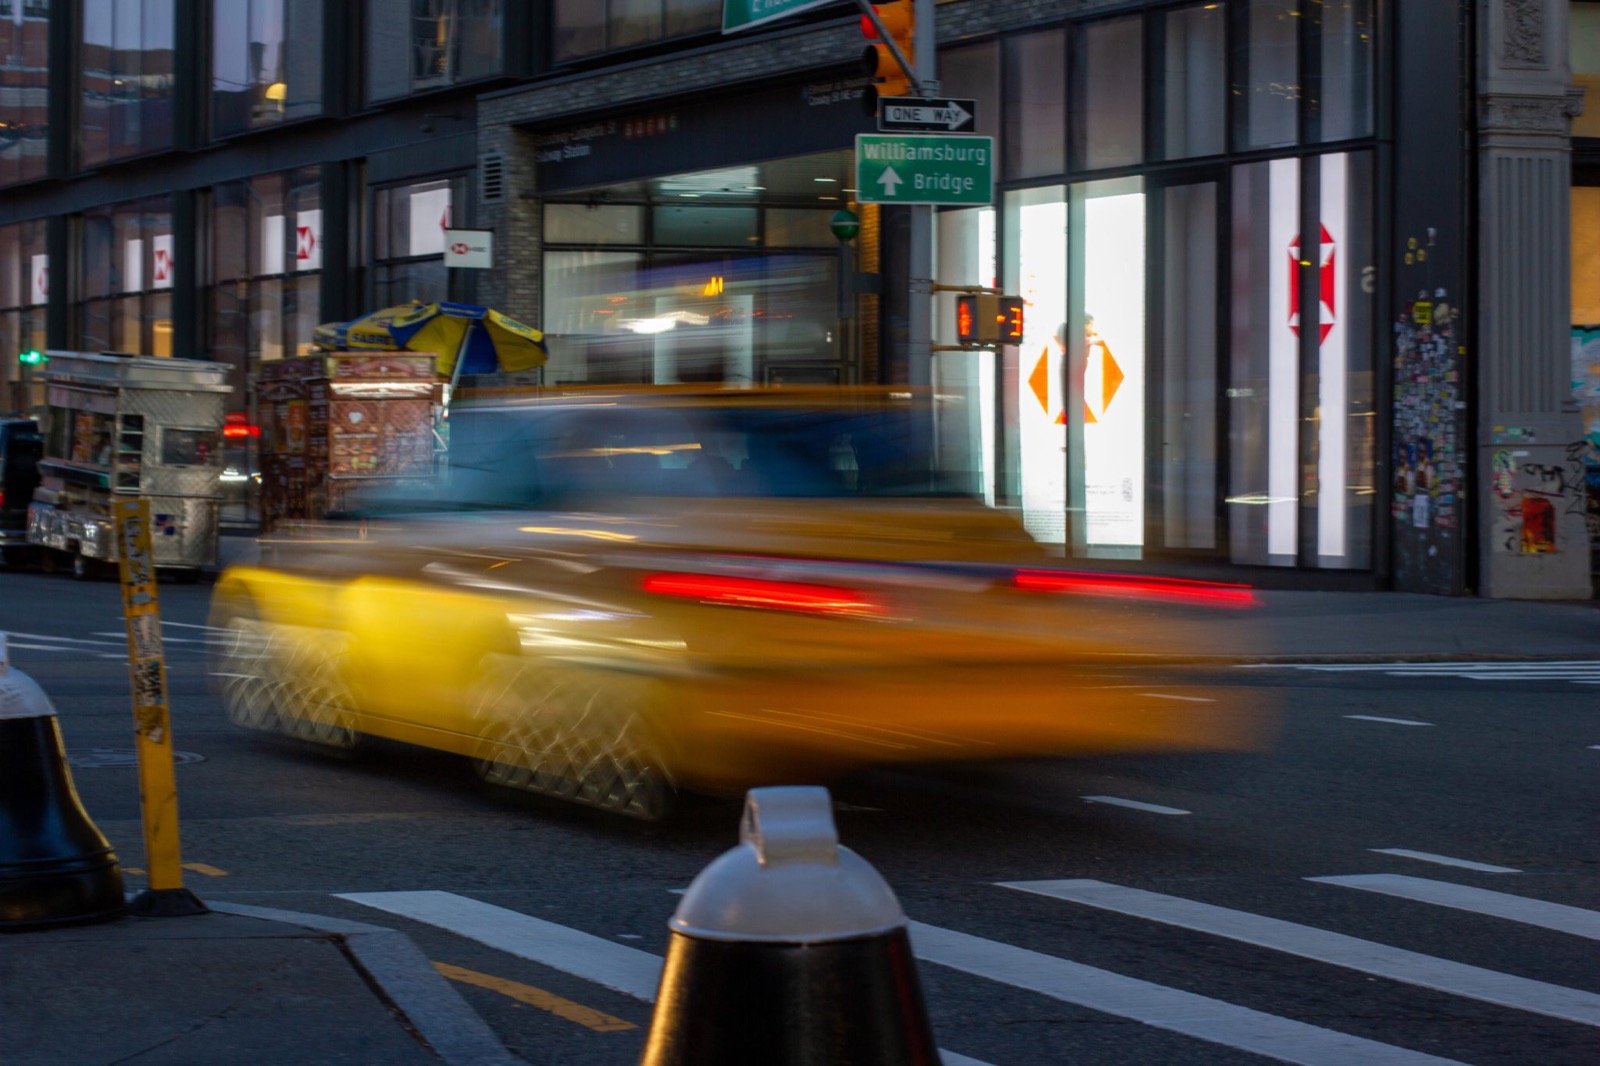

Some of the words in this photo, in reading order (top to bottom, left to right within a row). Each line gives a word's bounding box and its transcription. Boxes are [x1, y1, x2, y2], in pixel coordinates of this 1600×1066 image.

[892, 107, 922, 121] ONE
[932, 109, 961, 123] WAY
[863, 142, 987, 166] Williamsburg
[914, 172, 975, 195] Bridge
[352, 332, 395, 346] SABRE
